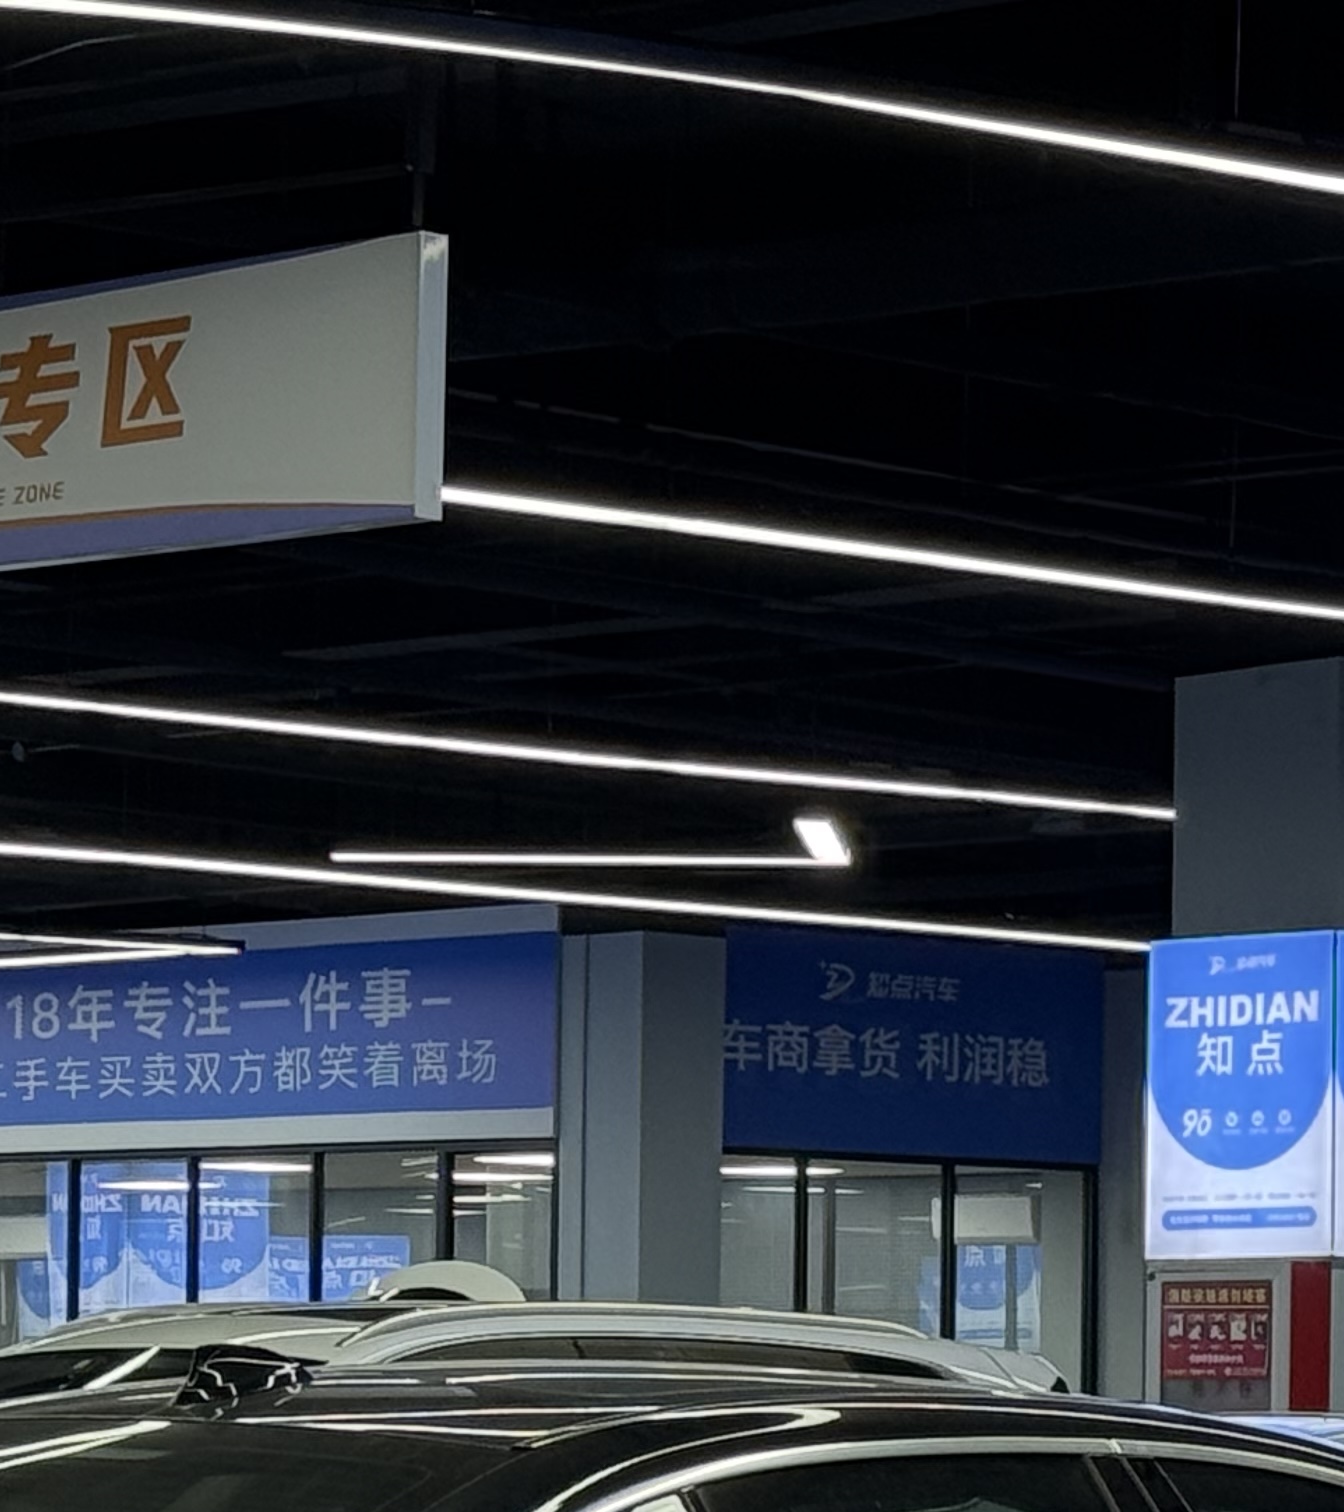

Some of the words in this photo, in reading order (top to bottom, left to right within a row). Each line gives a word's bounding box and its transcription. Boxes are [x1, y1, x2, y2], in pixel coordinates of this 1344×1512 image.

[13, 481, 65, 506] ZONE
[866, 970, 962, 1002] 知点汽车
[1164, 990, 1320, 1028] ZHIDIAN
[724, 1019, 901, 1079] 车商拿货
[917, 1032, 1049, 1088] 利润稳
[1196, 1030, 1284, 1076] 知点
